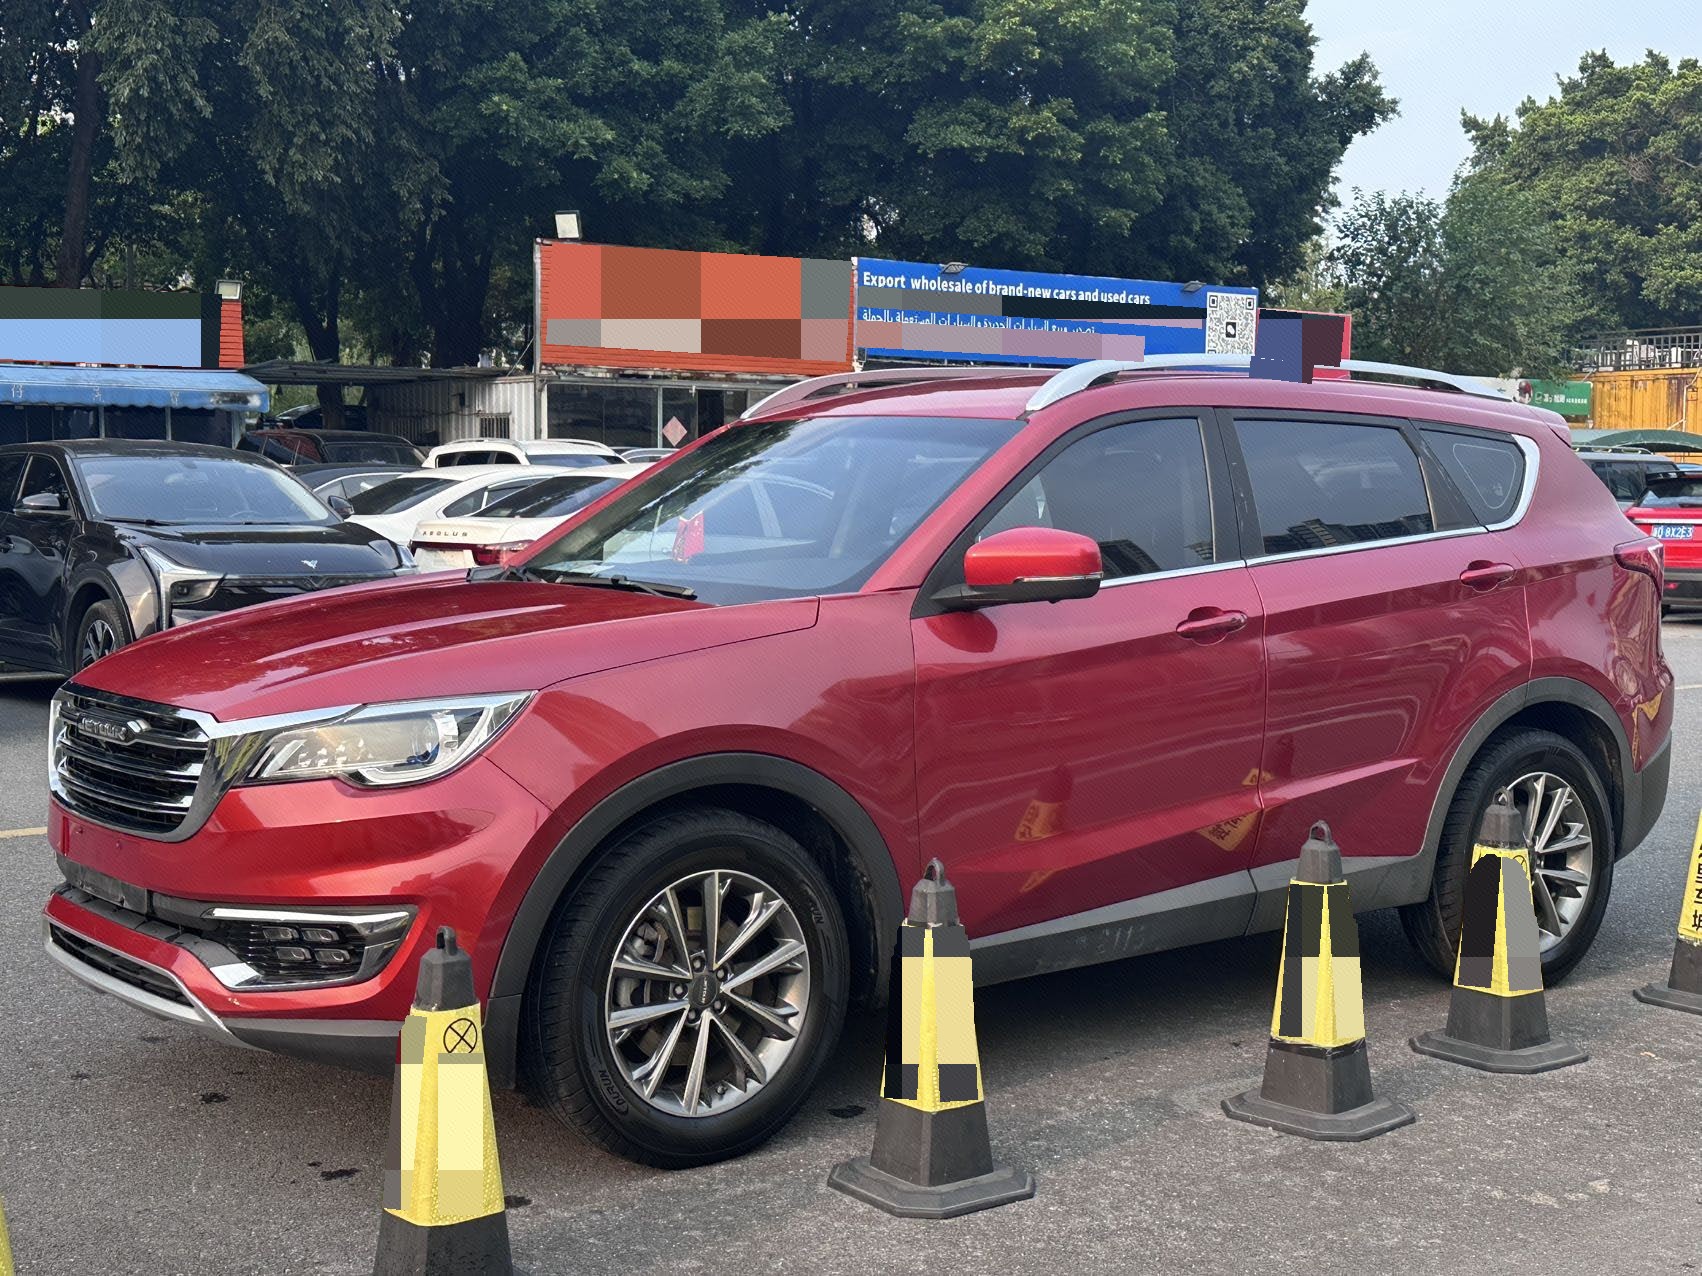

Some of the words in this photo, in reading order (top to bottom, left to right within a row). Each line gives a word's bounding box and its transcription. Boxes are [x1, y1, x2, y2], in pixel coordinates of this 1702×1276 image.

[863, 271, 906, 288] Export
[910, 275, 973, 293] wholesale
[975, 279, 989, 294] of
[989, 280, 1051, 298] brand-new
[1053, 287, 1077, 300] cars
[1078, 288, 1099, 301] and
[1101, 290, 1126, 303] used
[1128, 293, 1151, 305] cars
[79, 717, 127, 741] JETOUR
